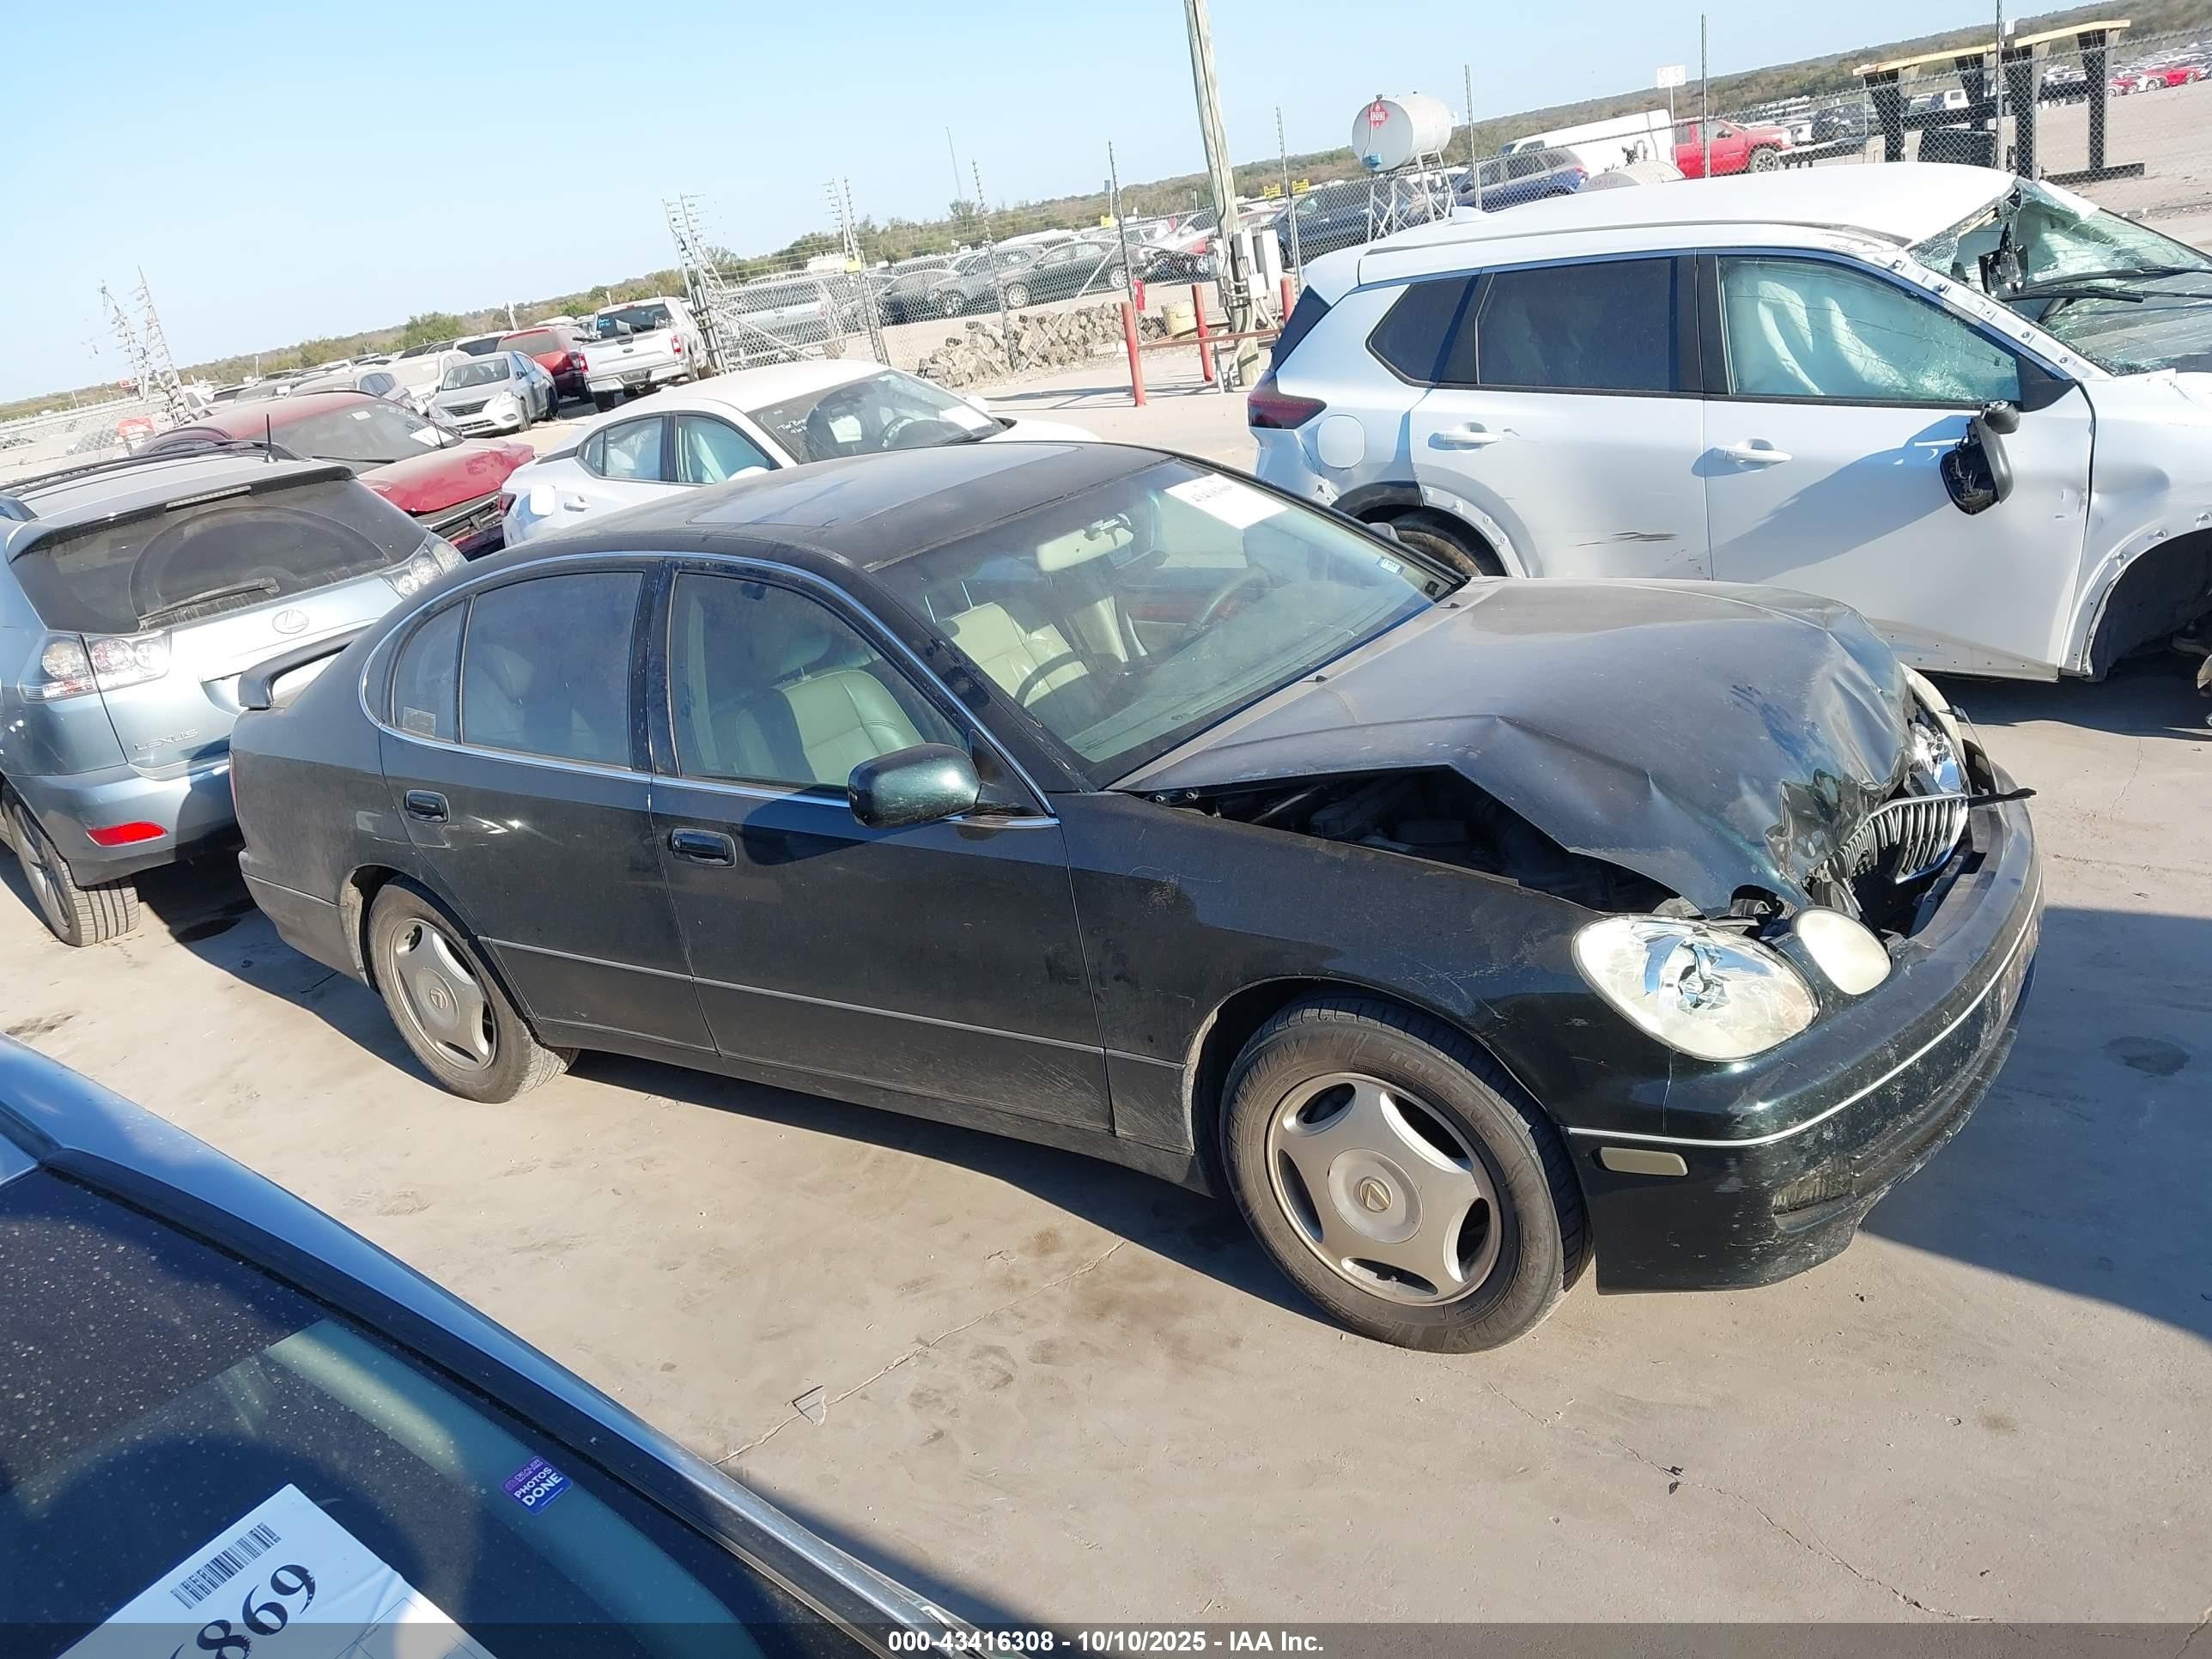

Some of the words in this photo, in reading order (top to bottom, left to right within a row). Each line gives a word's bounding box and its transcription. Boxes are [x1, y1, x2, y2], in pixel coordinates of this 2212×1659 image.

[134, 728, 199, 751] LEXUS
[514, 1467, 552, 1498] PHOTOS
[521, 1472, 563, 1506] DONE
[170, 1564, 316, 1659] 869
